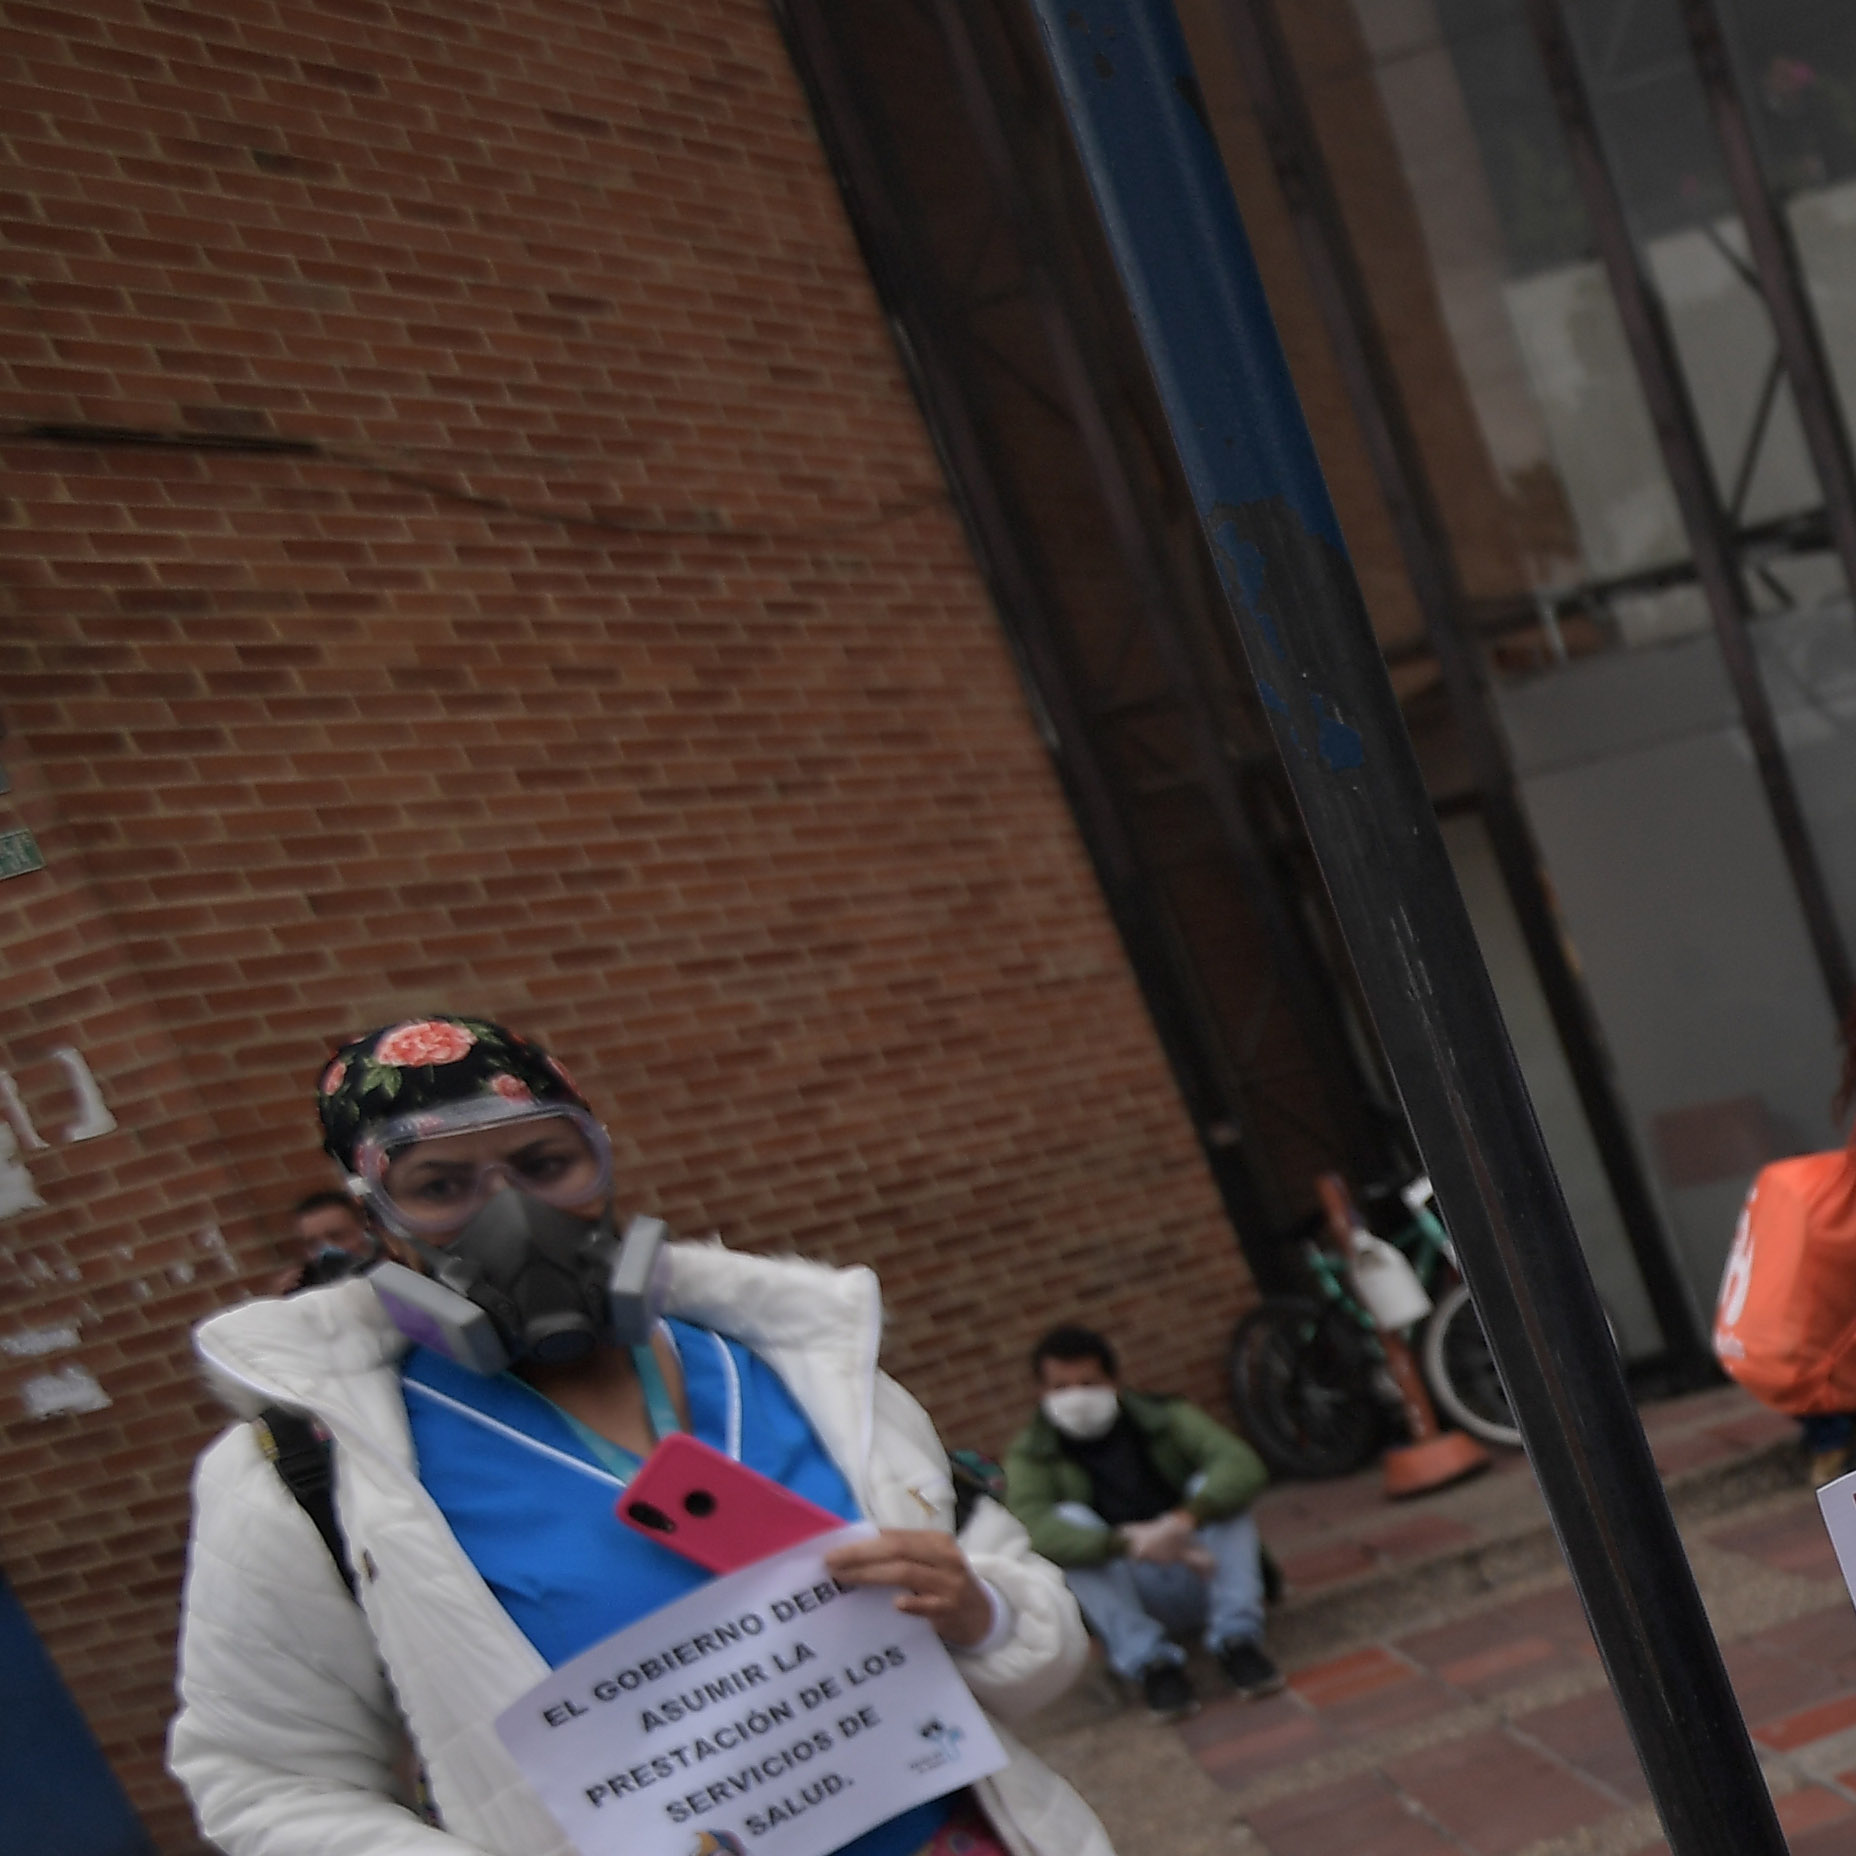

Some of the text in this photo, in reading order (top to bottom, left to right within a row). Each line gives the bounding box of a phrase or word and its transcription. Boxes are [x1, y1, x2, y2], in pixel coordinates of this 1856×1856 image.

[543, 1700, 589, 1727] EL
[594, 1613, 765, 1702] GOBIERNO
[585, 1646, 906, 1808] PRESTACIÓN DE LOS
[641, 1641, 816, 1733] ASUMIR LA
[666, 1705, 881, 1823] SERVICIOS DE
[745, 1774, 855, 1836] SALUD.
